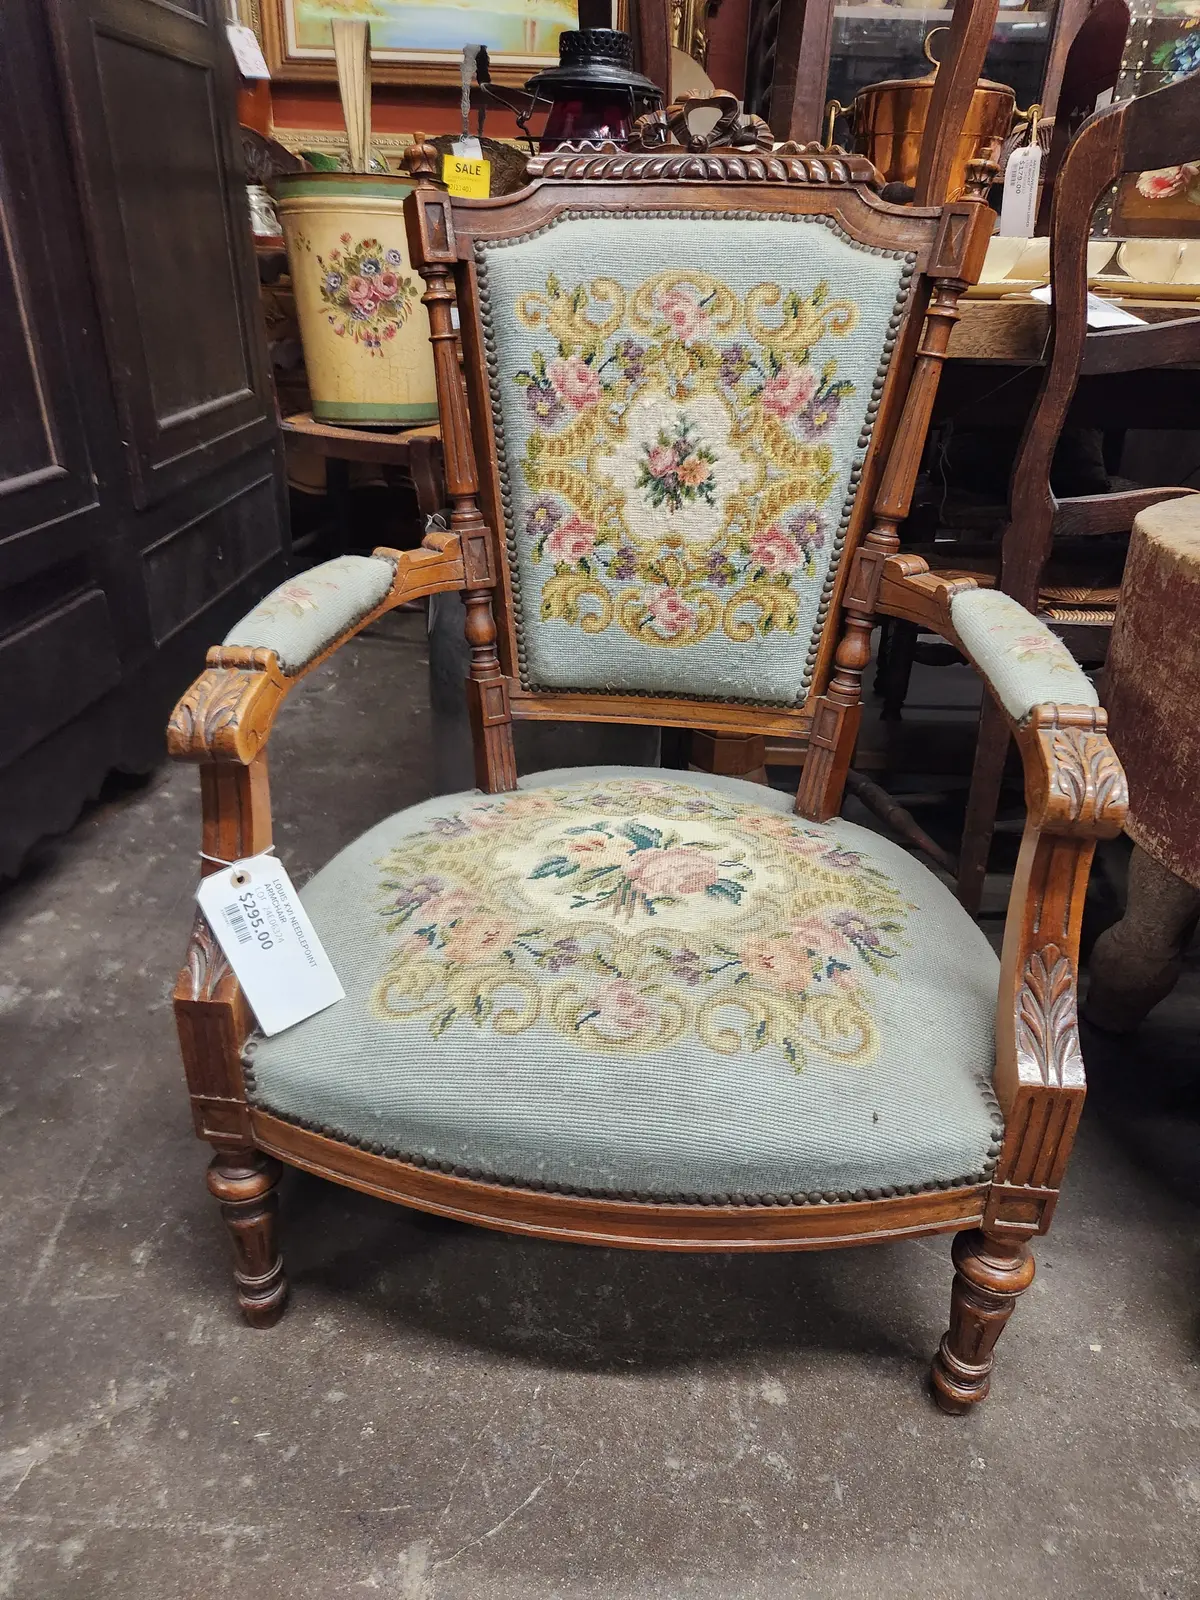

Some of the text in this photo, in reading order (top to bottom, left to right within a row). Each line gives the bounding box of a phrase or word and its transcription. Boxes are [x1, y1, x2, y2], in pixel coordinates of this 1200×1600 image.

[455, 162, 482, 176] SALE
[238, 892, 274, 950] $295.00
[264, 883, 288, 924] ARMCHAIR
[272, 878, 318, 968] LOUIS XVI NEEDLEPOINT
